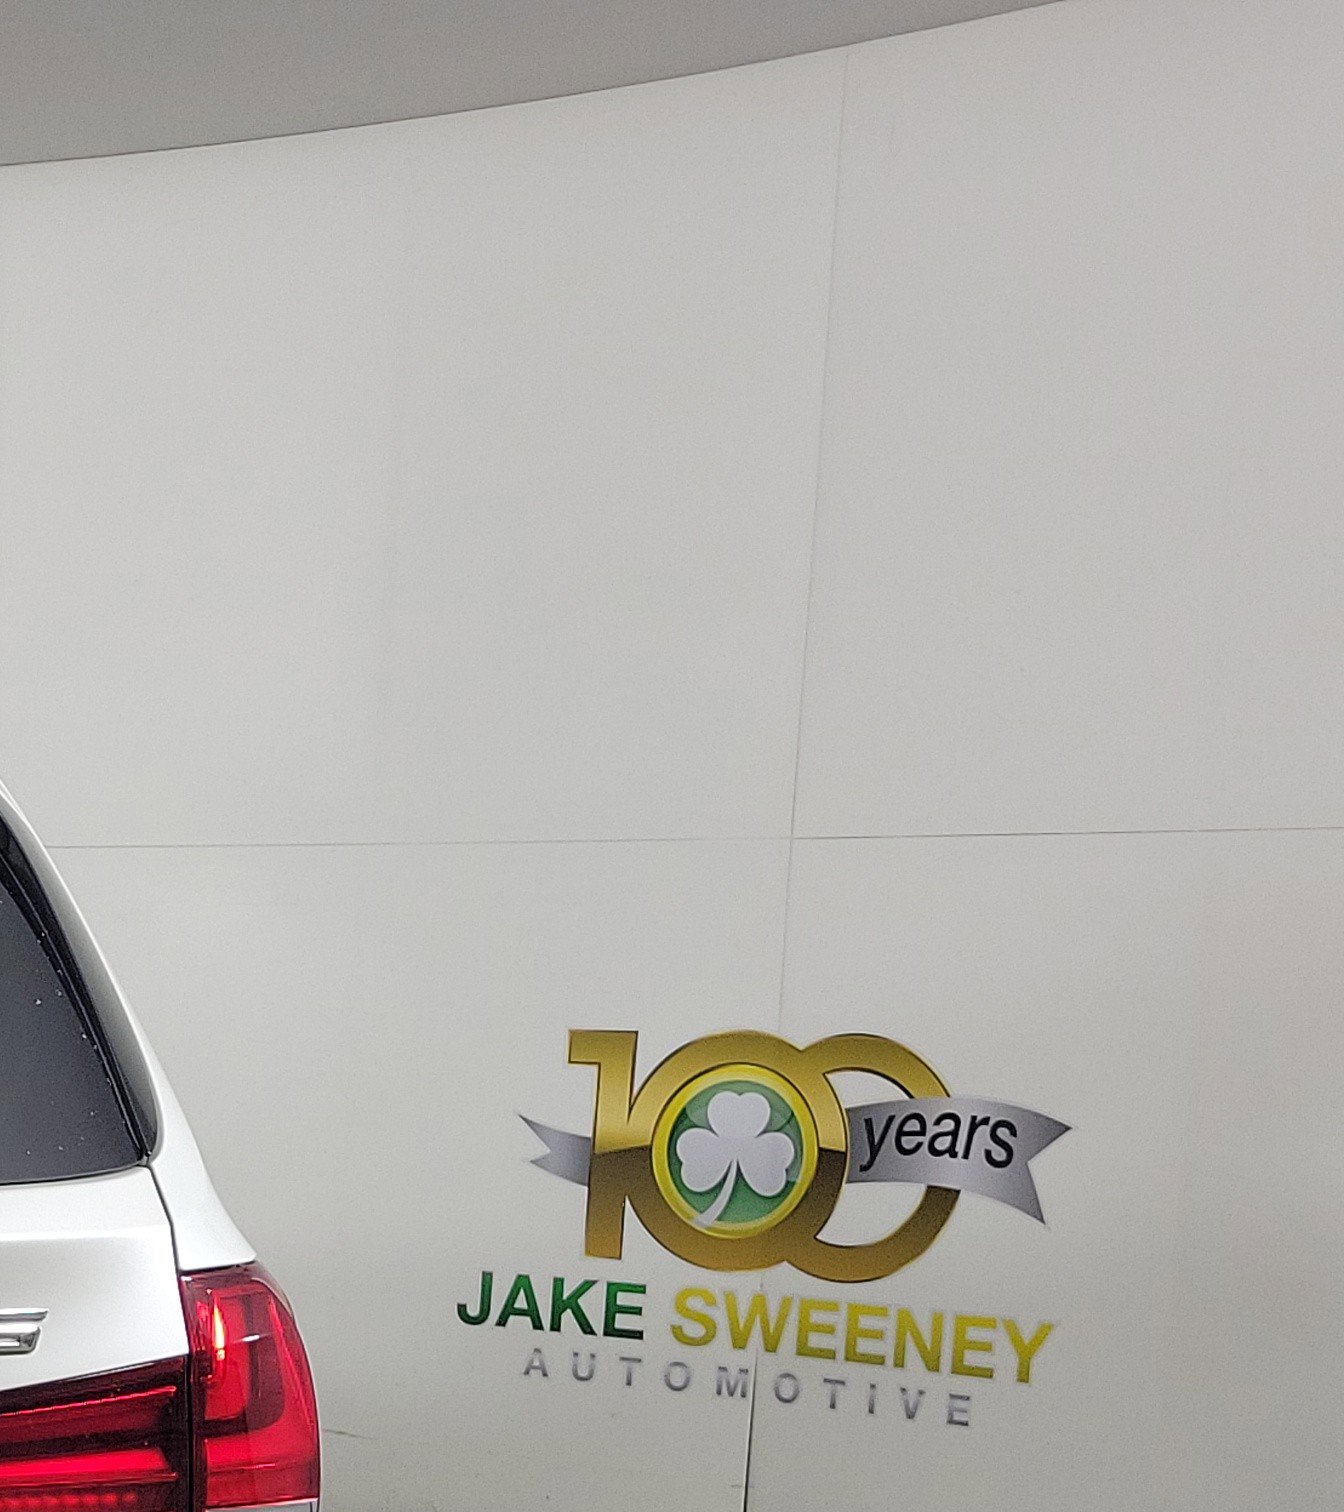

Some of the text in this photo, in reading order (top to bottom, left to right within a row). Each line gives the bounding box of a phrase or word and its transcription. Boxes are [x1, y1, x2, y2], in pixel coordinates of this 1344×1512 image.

[567, 1029, 1019, 1284] 100 years
[456, 1270, 1054, 1386] JAKE SWEENEY
[523, 1347, 973, 1427] AUTOMOTIVE
